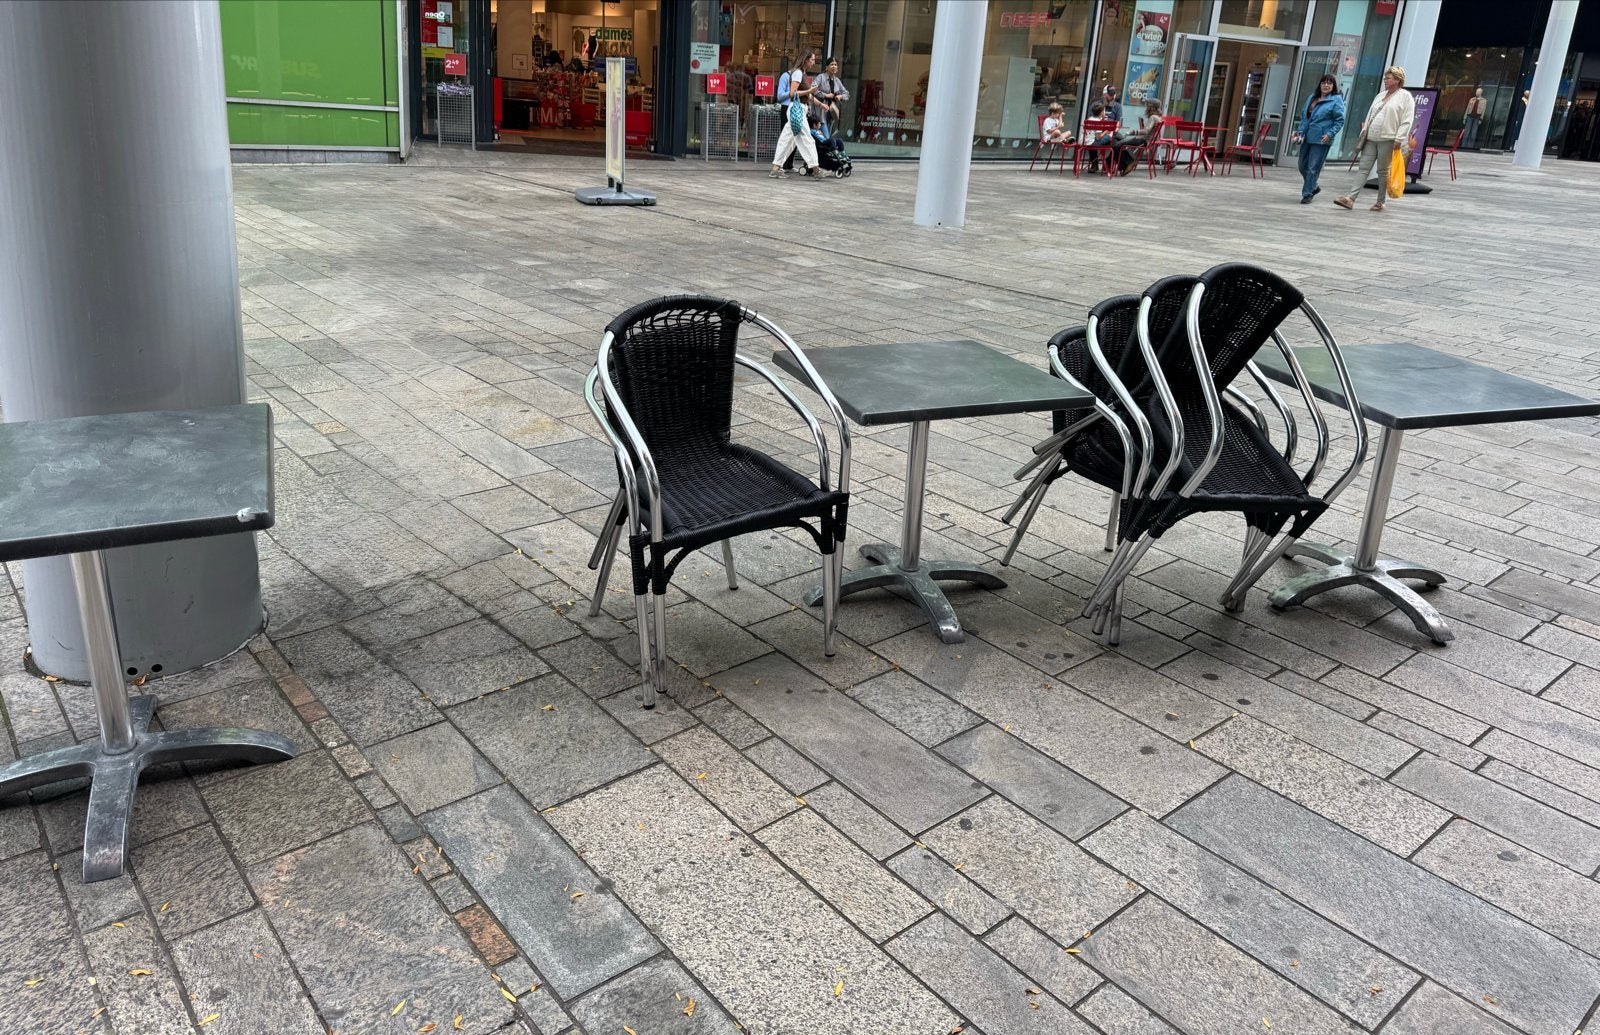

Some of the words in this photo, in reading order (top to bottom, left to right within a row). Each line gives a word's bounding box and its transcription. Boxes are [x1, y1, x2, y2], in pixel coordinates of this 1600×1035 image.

[596, 28, 632, 40] dames
[1137, 31, 1162, 42] erwten
[445, 60, 459, 69] 2.49
[1129, 80, 1157, 91] double
[1131, 90, 1148, 102] dog
[1414, 94, 1429, 105] ffie
